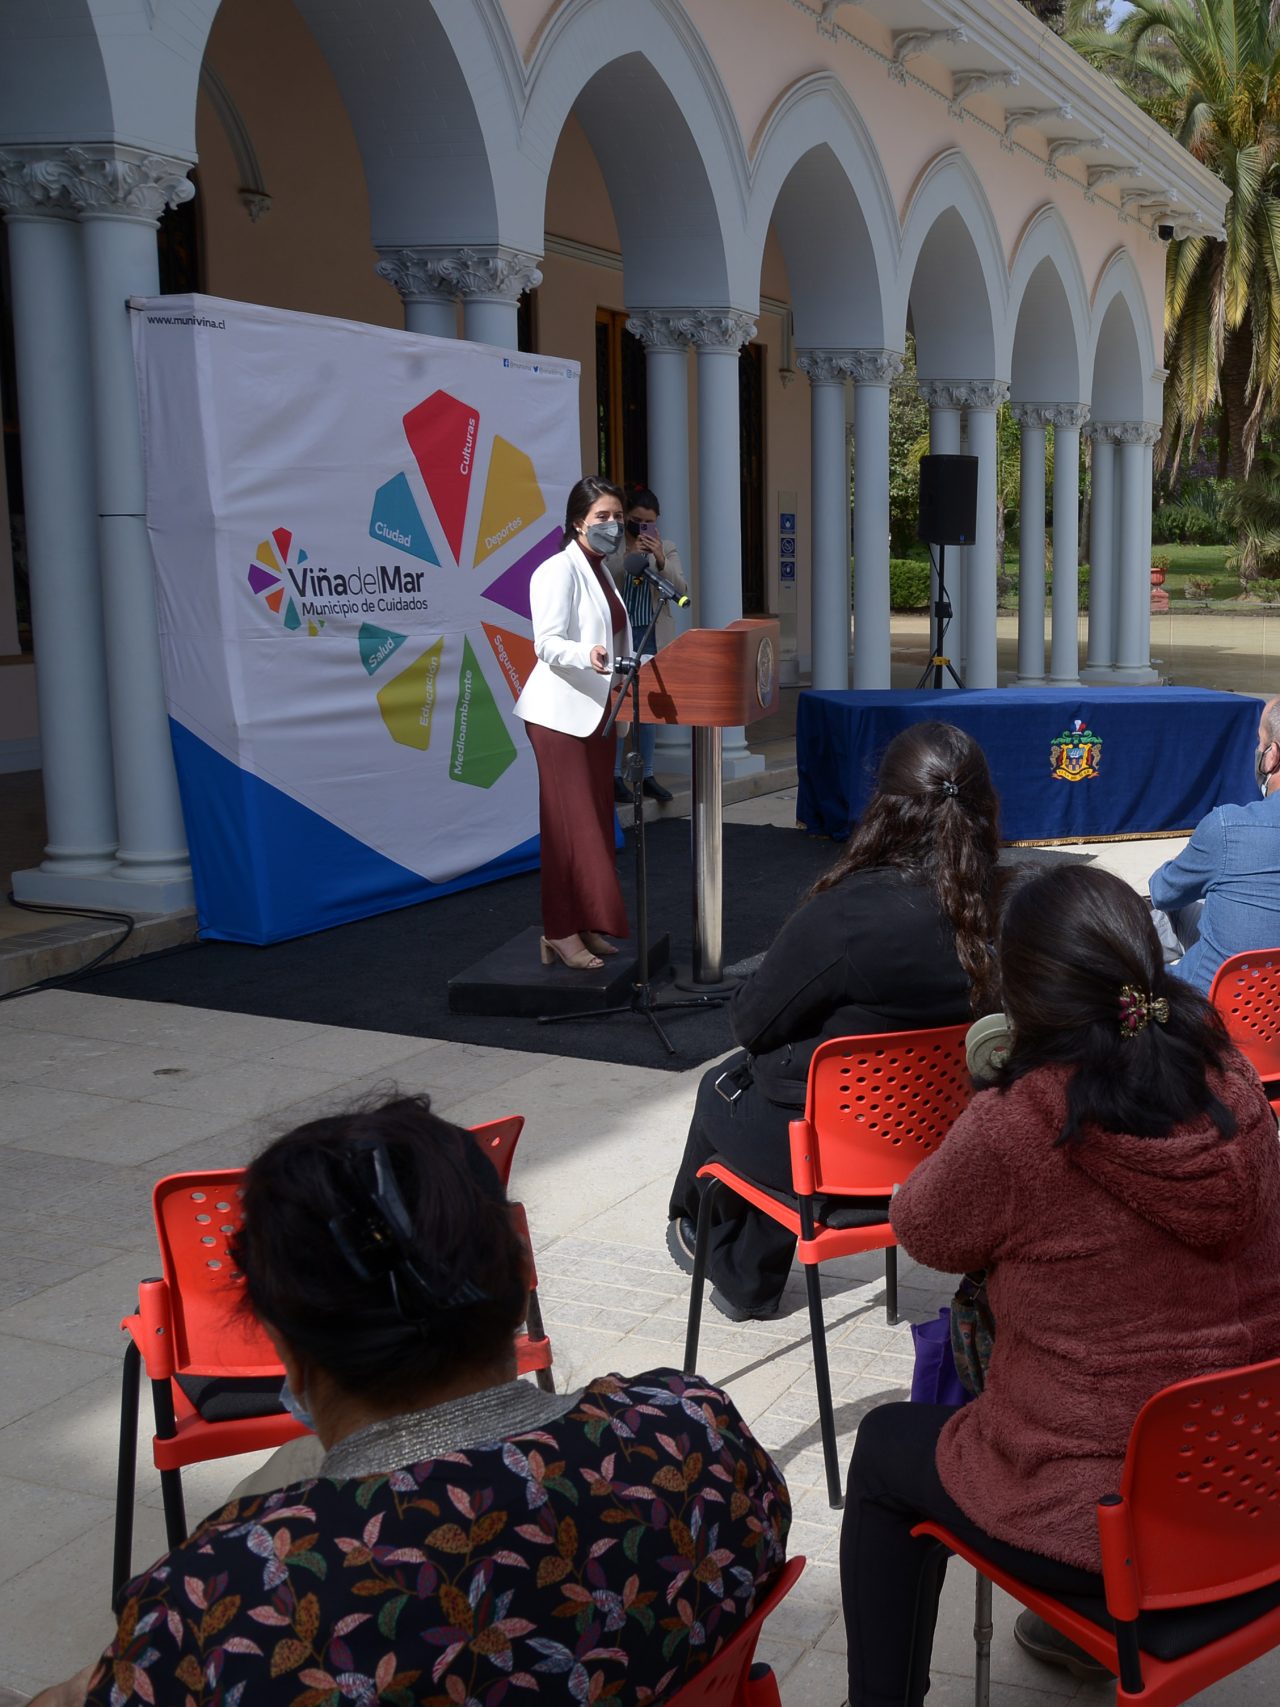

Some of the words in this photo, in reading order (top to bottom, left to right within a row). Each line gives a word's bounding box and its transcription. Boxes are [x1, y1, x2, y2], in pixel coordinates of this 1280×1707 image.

[147, 315, 226, 330] www.munivina.cl
[460, 418, 476, 475] Culturas
[375, 521, 412, 547] Ciudad
[485, 517, 523, 549] Deportes
[302, 600, 359, 619] Municipio
[361, 599, 375, 613] de
[377, 596, 429, 612] Cuidados
[368, 636, 396, 668] Salud
[419, 656, 438, 727] Educación
[454, 670, 473, 775] Medioambiente
